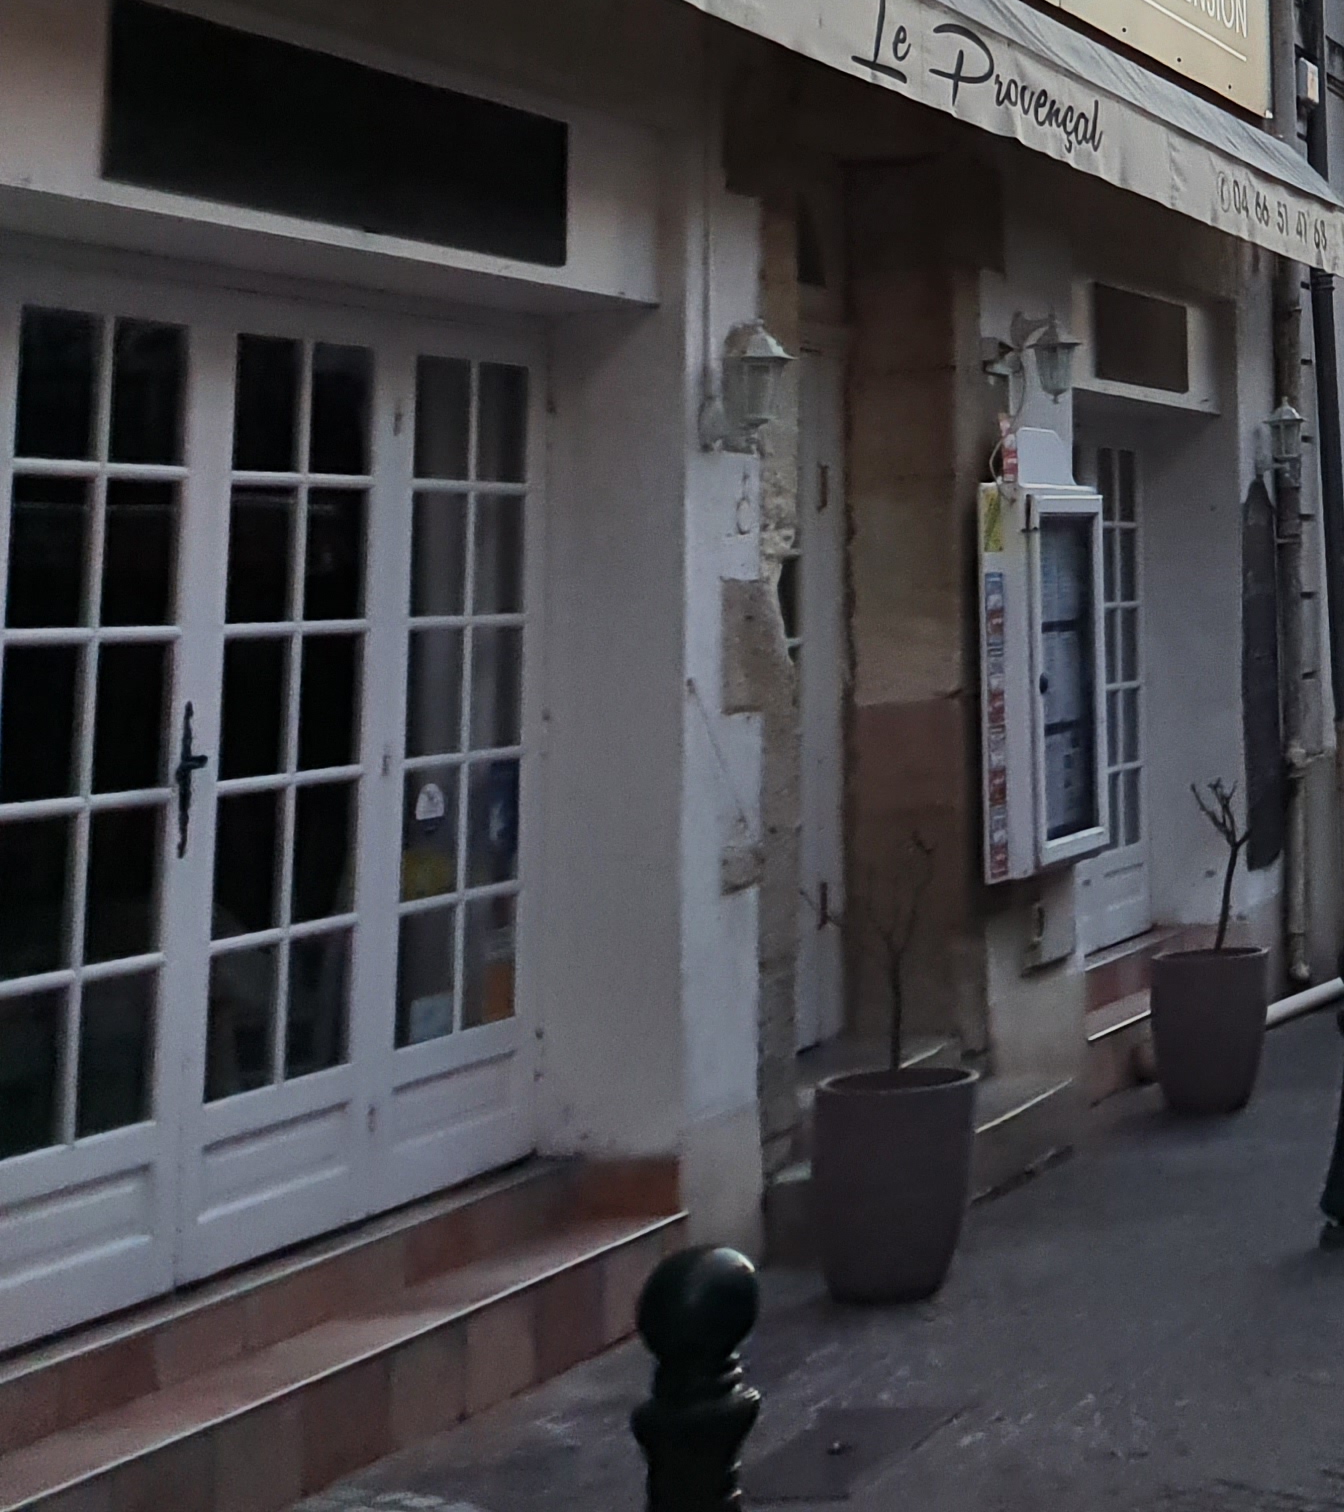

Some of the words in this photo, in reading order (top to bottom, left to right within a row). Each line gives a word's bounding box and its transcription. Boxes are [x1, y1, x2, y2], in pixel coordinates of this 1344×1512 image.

[928, 22, 1104, 153] Provençal
[1232, 179, 1250, 219] 04
[1255, 190, 1270, 227] 66
